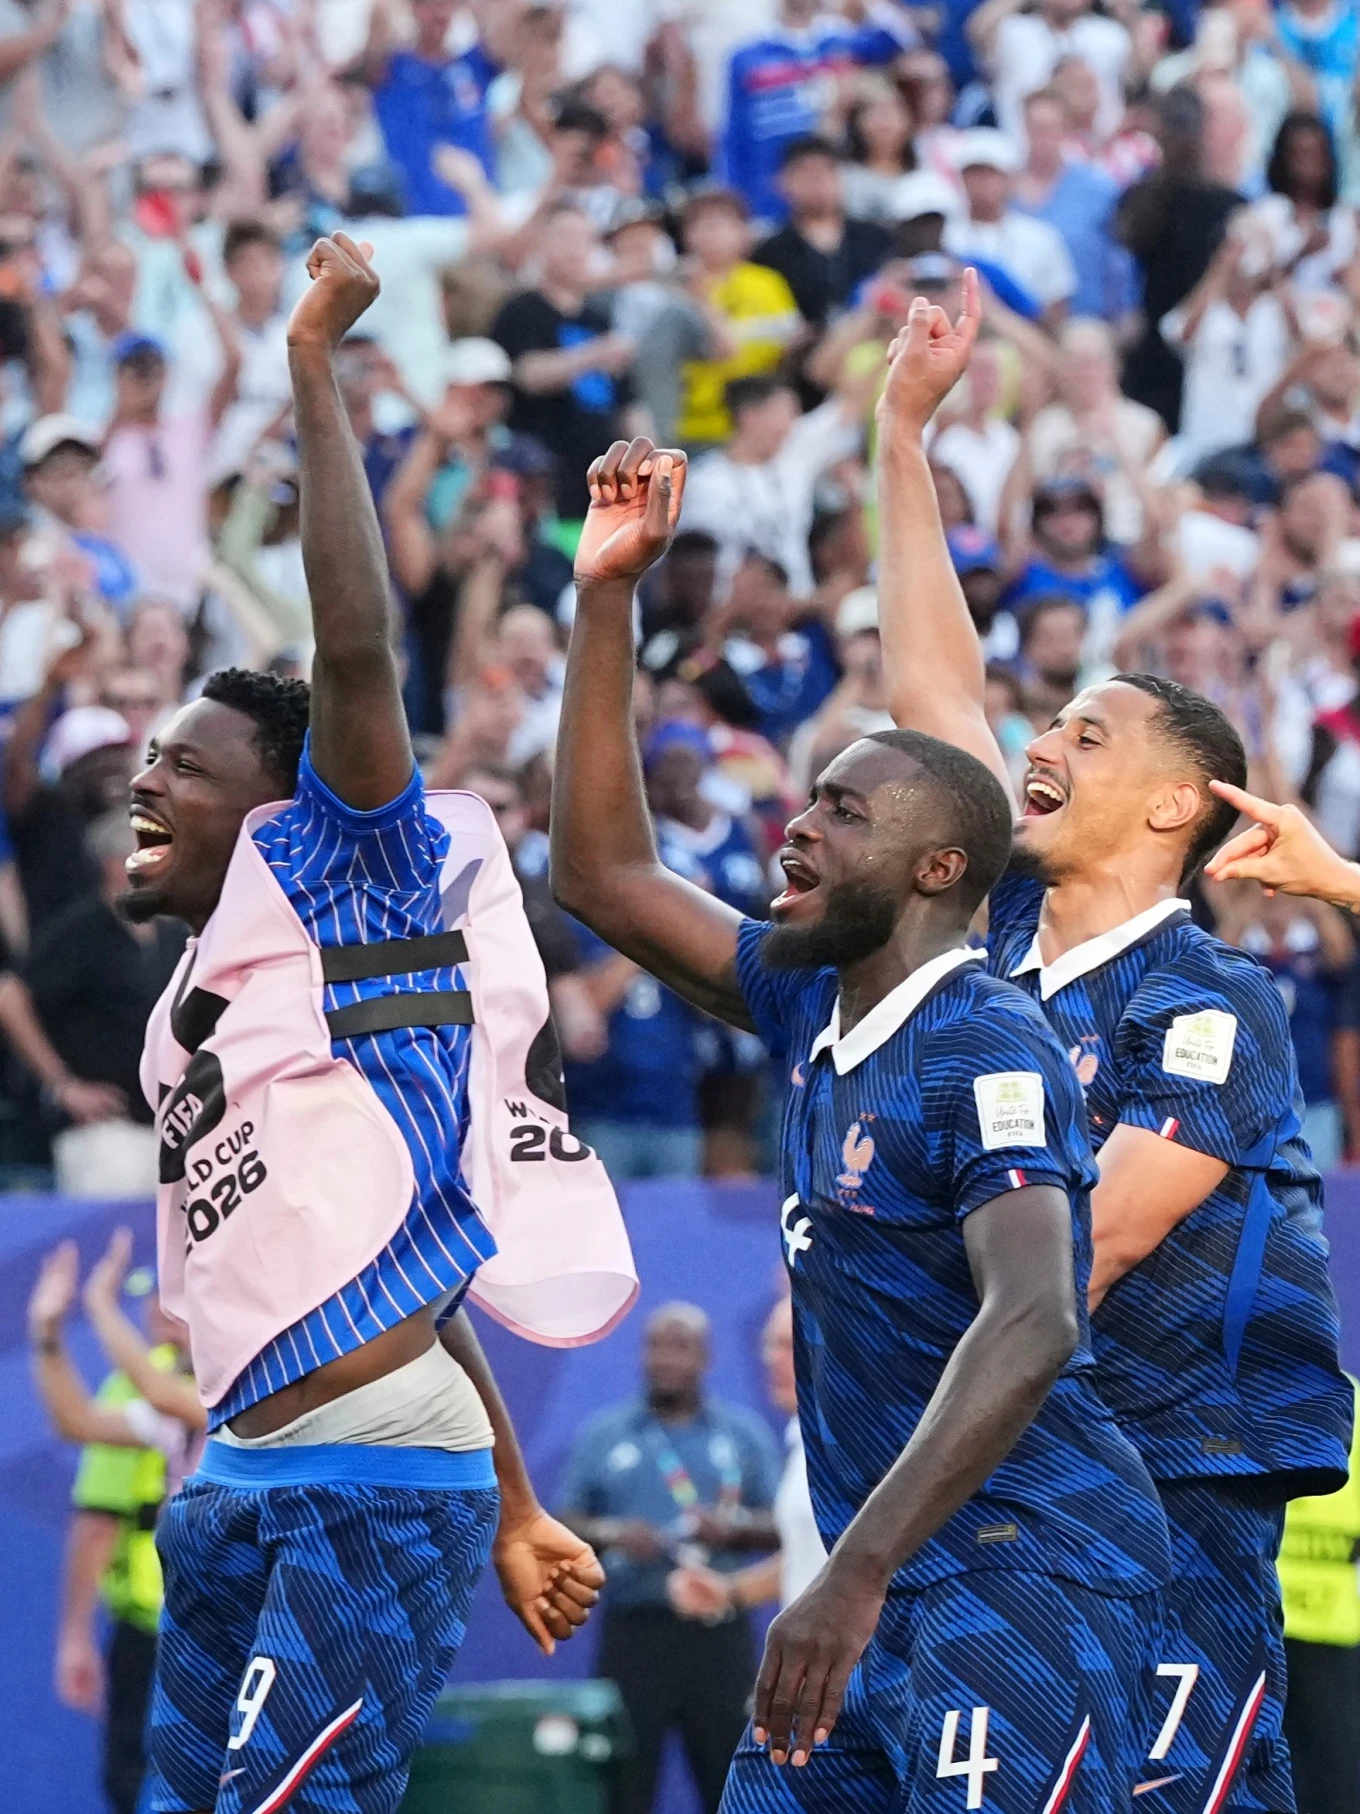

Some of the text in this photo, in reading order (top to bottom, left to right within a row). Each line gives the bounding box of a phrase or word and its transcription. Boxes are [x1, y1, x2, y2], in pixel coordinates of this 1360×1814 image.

[162, 1092, 203, 1150] FIFA
[215, 1120, 255, 1166] CUP
[509, 1124, 591, 1162] 20
[186, 1150, 268, 1255] 026
[780, 1191, 814, 1268] 4
[227, 1656, 277, 1750] 9
[1148, 1663, 1199, 1760] 7
[936, 1706, 999, 1810] 4
